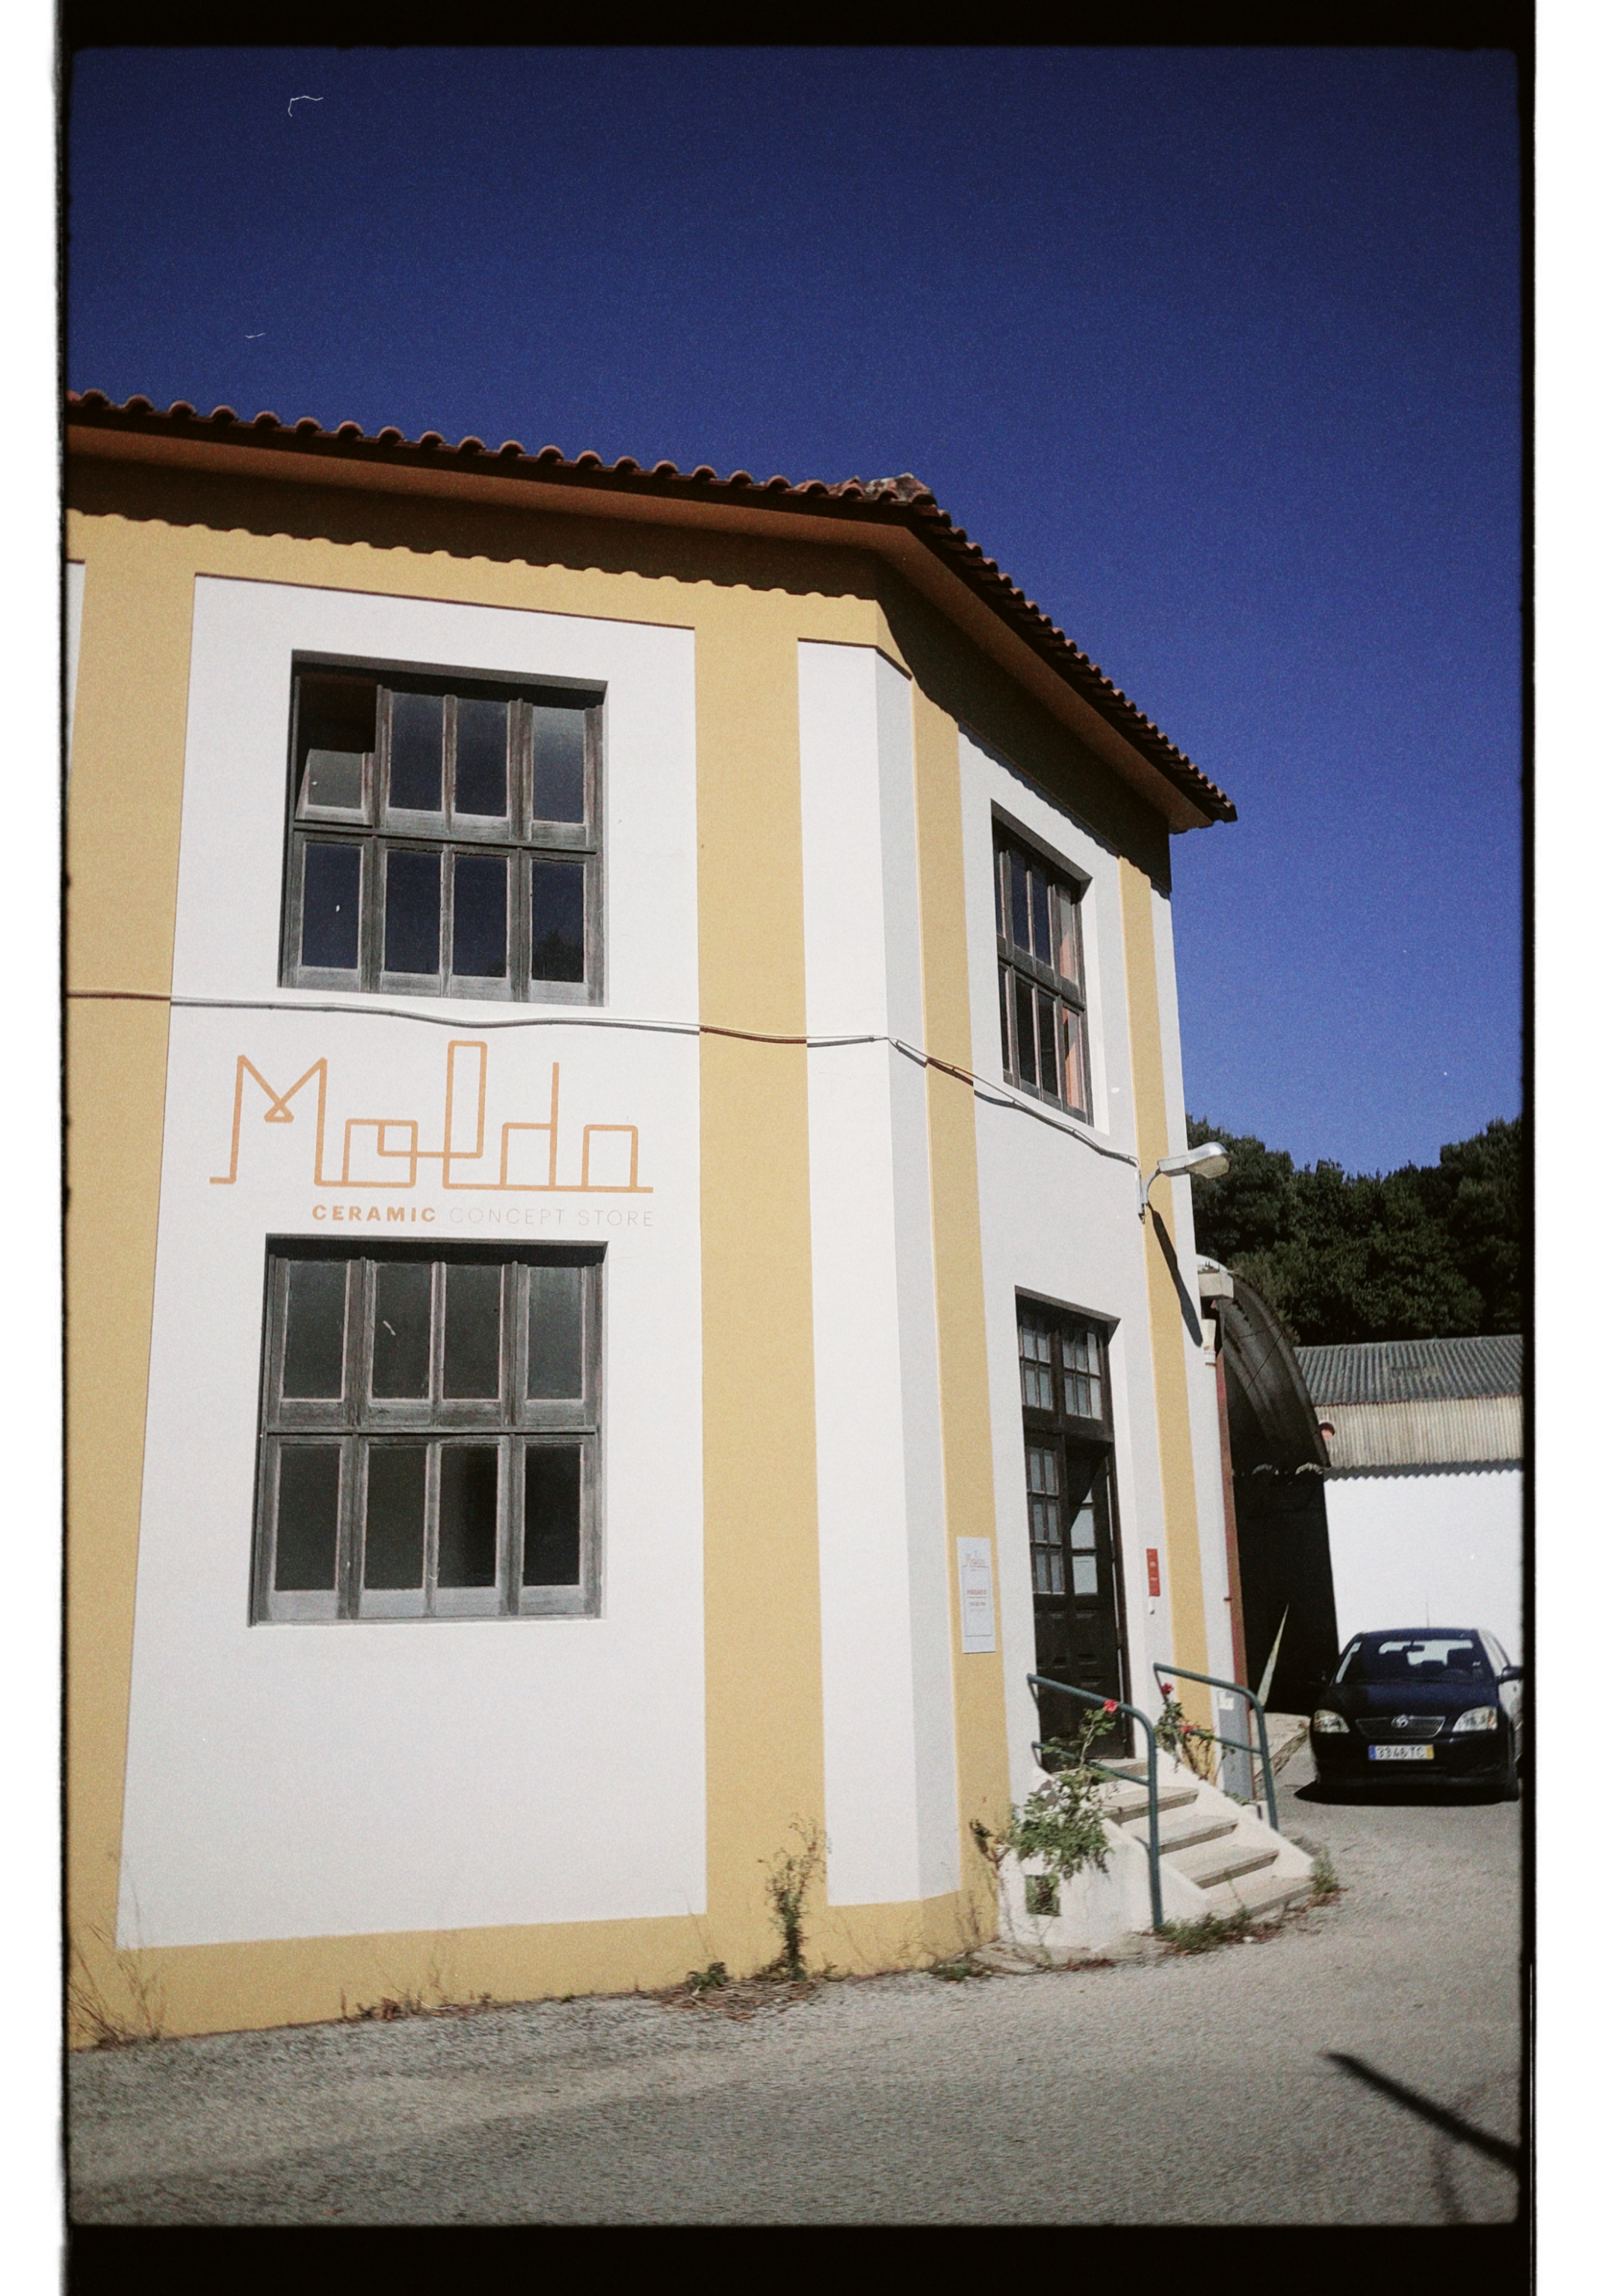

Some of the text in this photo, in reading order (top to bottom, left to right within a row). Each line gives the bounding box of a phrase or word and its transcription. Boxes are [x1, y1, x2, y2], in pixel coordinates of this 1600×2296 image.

[312, 1204, 653, 1226] CERAMIC CONCEPT STORE
